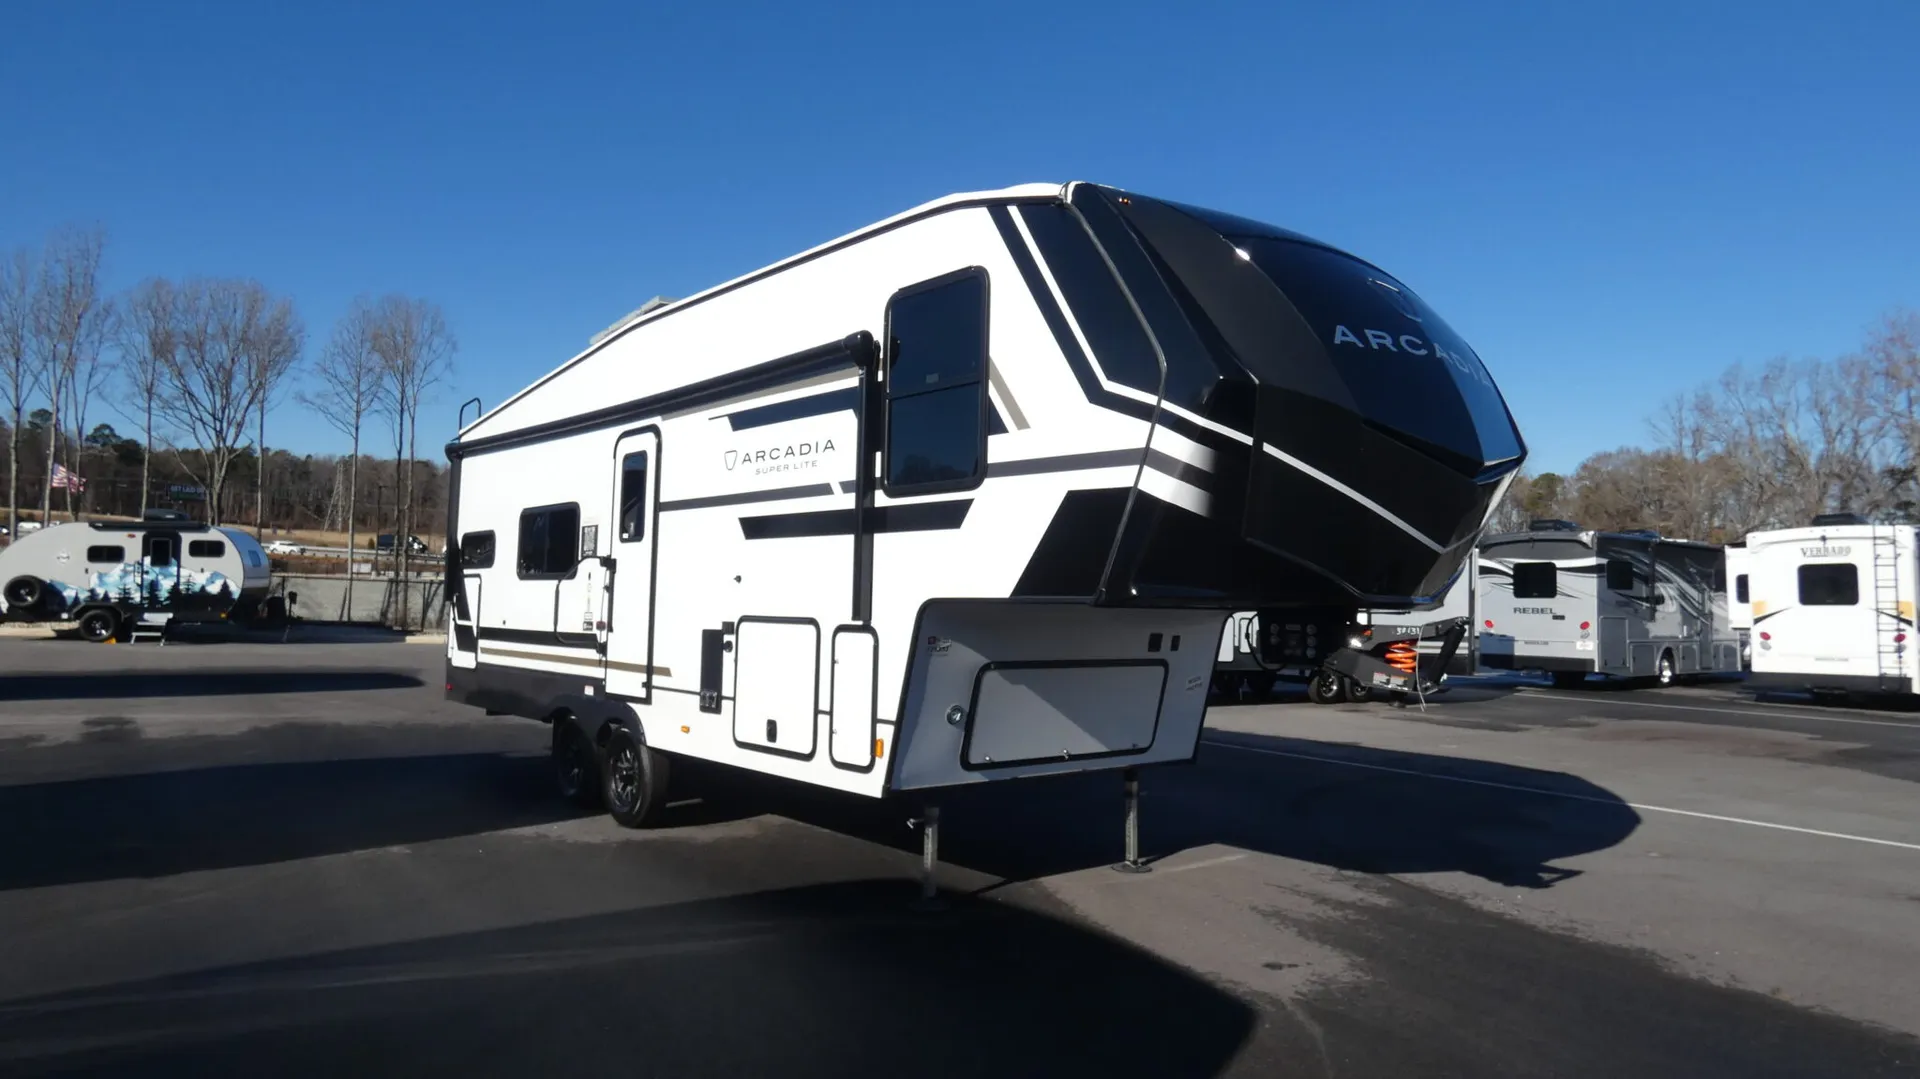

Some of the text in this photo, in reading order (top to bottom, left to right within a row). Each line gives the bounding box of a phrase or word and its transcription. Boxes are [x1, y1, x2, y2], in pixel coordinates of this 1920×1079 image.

[1333, 325, 1496, 389] ARCADIA
[741, 439, 836, 465] ARCADIA
[755, 460, 818, 475] SUPER LITE
[1513, 607, 1557, 615] REBEL
